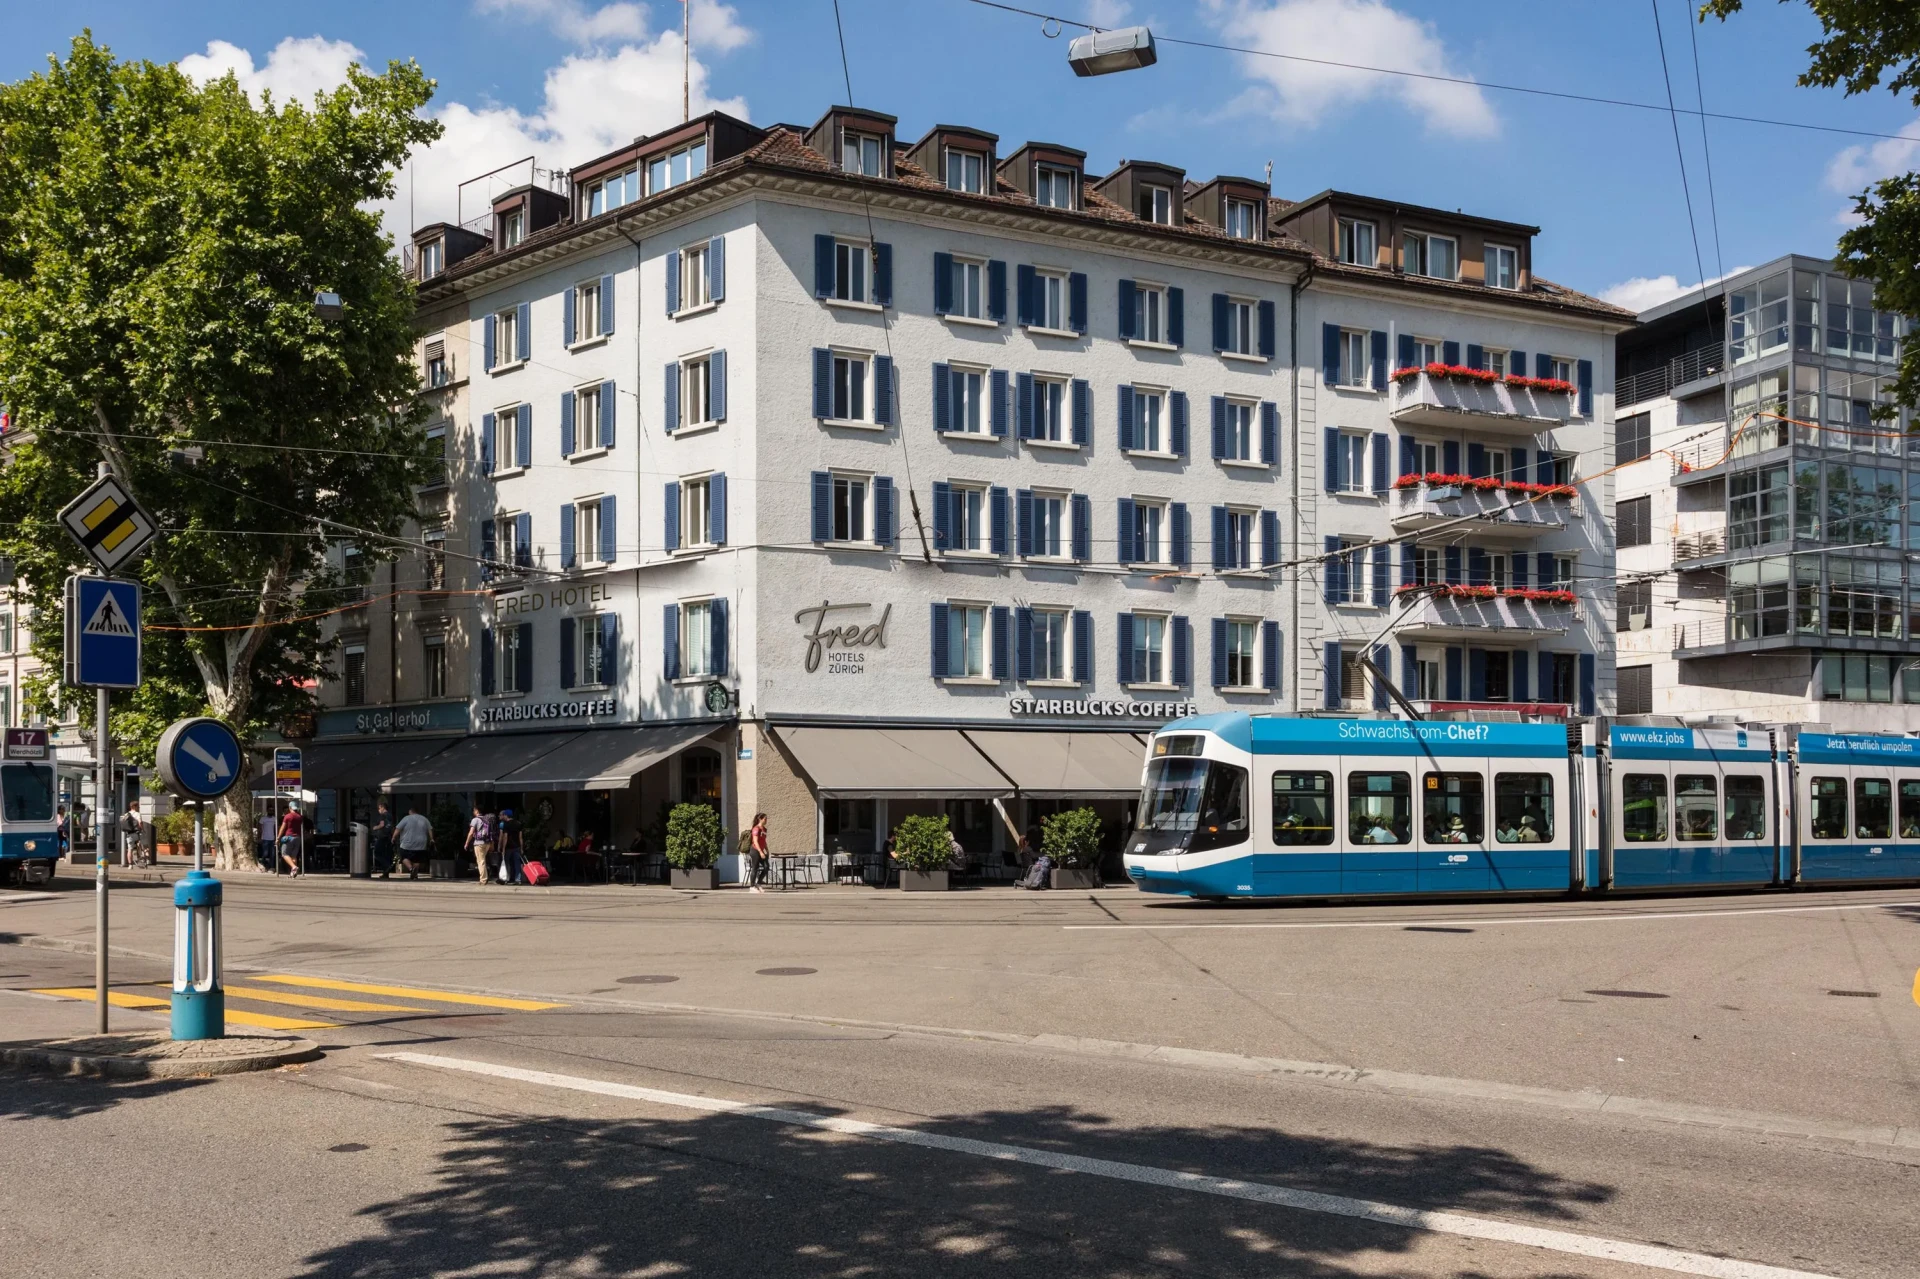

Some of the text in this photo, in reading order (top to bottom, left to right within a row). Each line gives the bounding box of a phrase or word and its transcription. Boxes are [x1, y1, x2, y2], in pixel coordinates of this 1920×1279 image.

[494, 583, 612, 616] FRED HOTEL
[794, 599, 893, 674] Fred
[828, 652, 865, 663] HOTELS
[828, 664, 864, 674] ZÜRICH
[480, 699, 614, 722] STARBUCKS COFFEE
[1010, 698, 1197, 717] STARBUCKS COFFEE
[17, 731, 36, 745] 17
[1338, 721, 1489, 741] Schwachstrom-Chef?
[1620, 731, 1685, 747] www.ekz.jobs
[1826, 737, 1913, 754] Jetzt beruflich umpolen
[1428, 778, 1437, 788] 13
